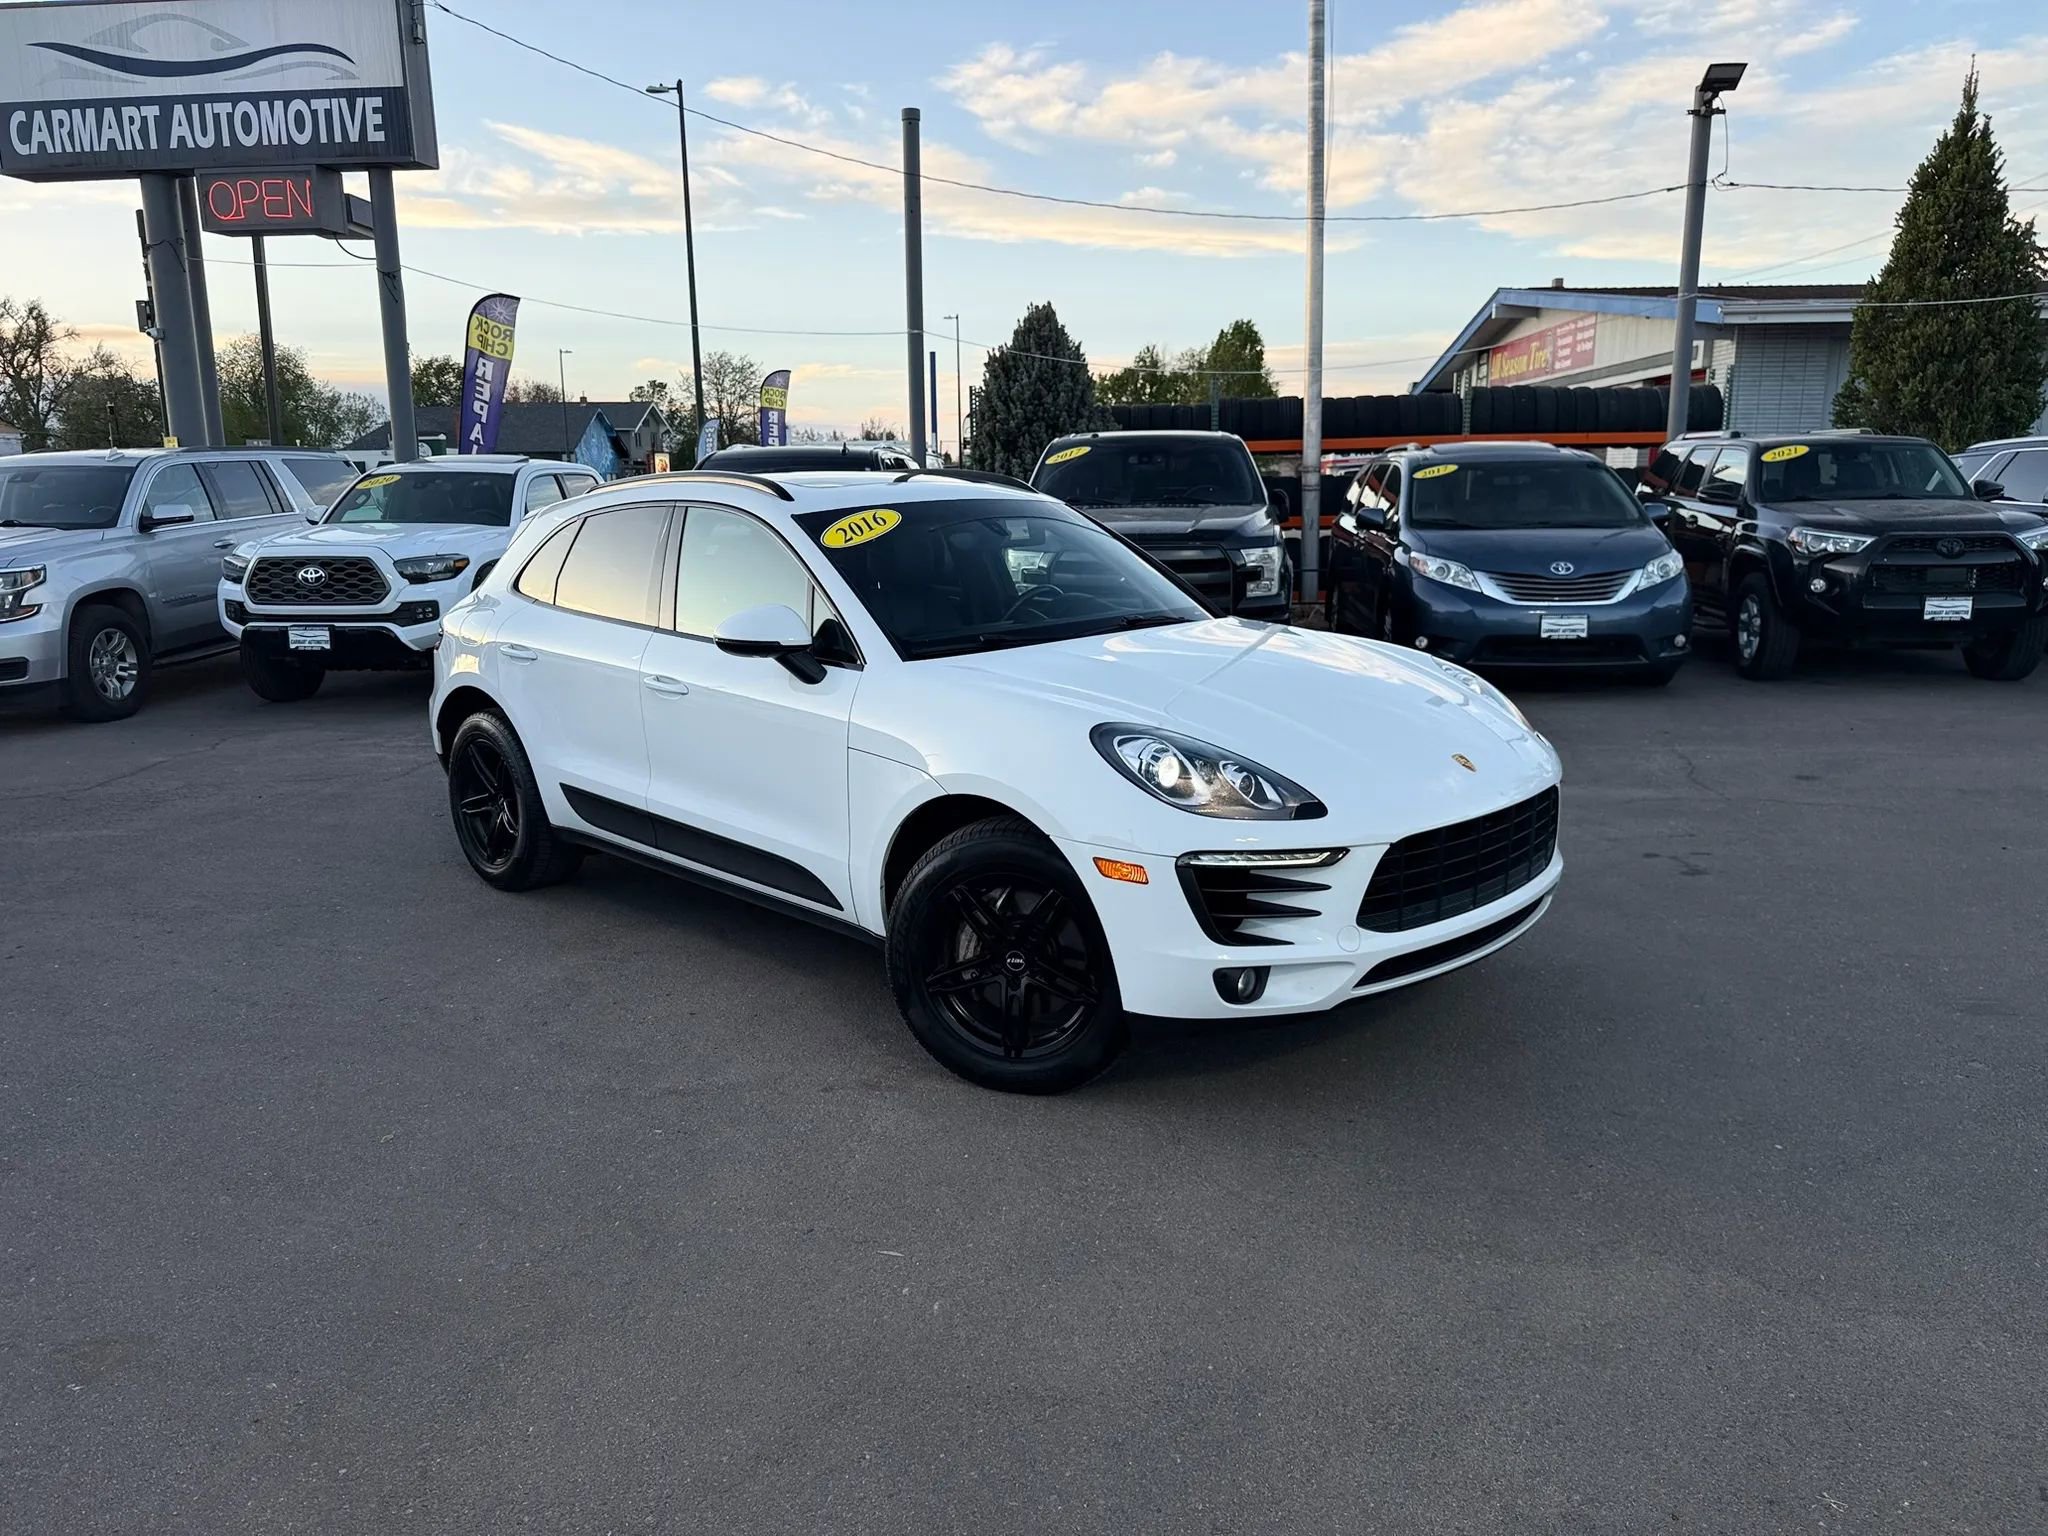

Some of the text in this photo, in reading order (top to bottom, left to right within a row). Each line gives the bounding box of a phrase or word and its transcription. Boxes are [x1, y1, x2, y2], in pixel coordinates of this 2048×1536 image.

[9, 96, 386, 155] CARMART AUTOMOTIVE
[208, 179, 313, 221] OPEN
[1770, 446, 1798, 460] 2021
[835, 511, 887, 544] 2016
